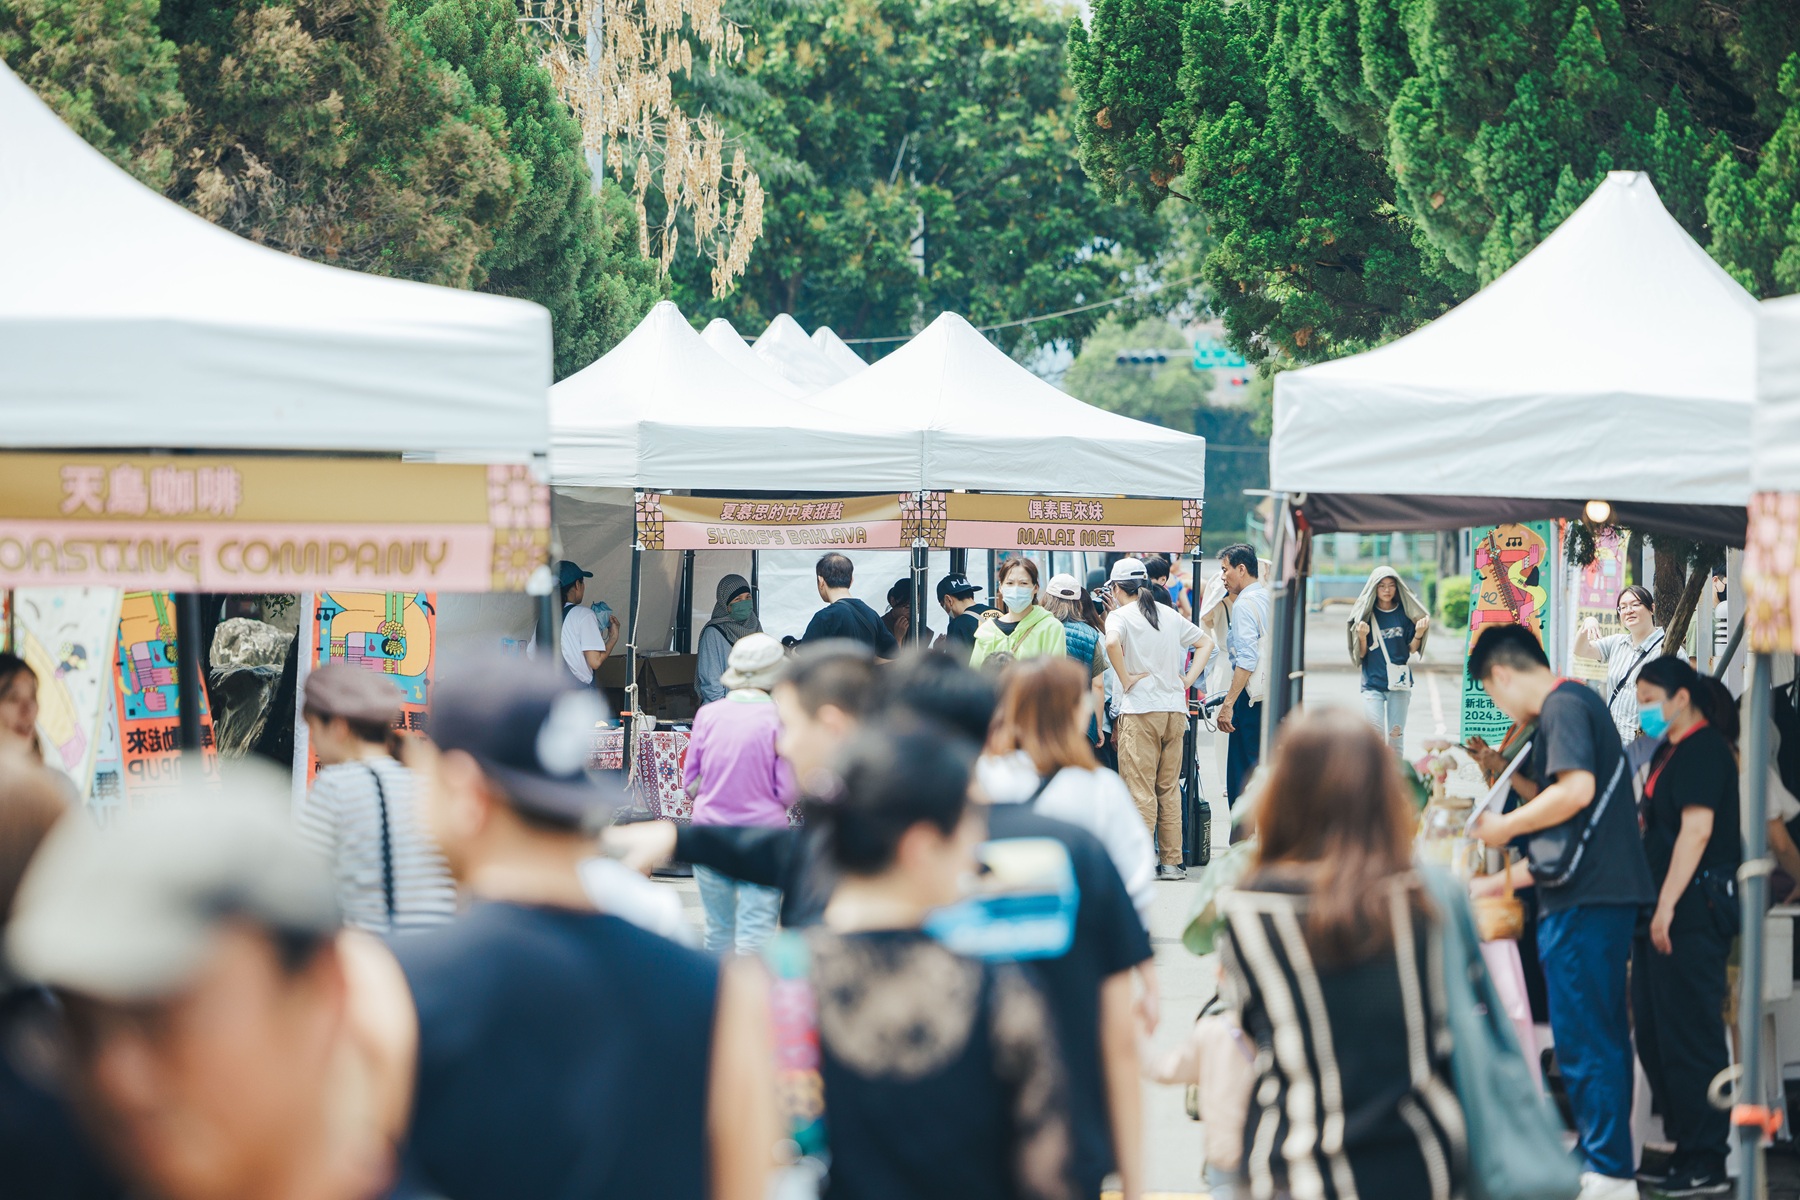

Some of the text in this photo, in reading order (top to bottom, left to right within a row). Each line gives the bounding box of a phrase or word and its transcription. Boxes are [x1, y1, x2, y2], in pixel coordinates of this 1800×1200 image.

[720, 501, 844, 522] 夏慕思的中東甜點
[1028, 499, 1104, 521] 偶素馬來妹
[786, 526, 867, 545] BAKLAVA
[1017, 527, 1115, 547] MALAI MEI
[217, 538, 450, 576] COMPANY
[1465, 698, 1497, 709] 新北市
